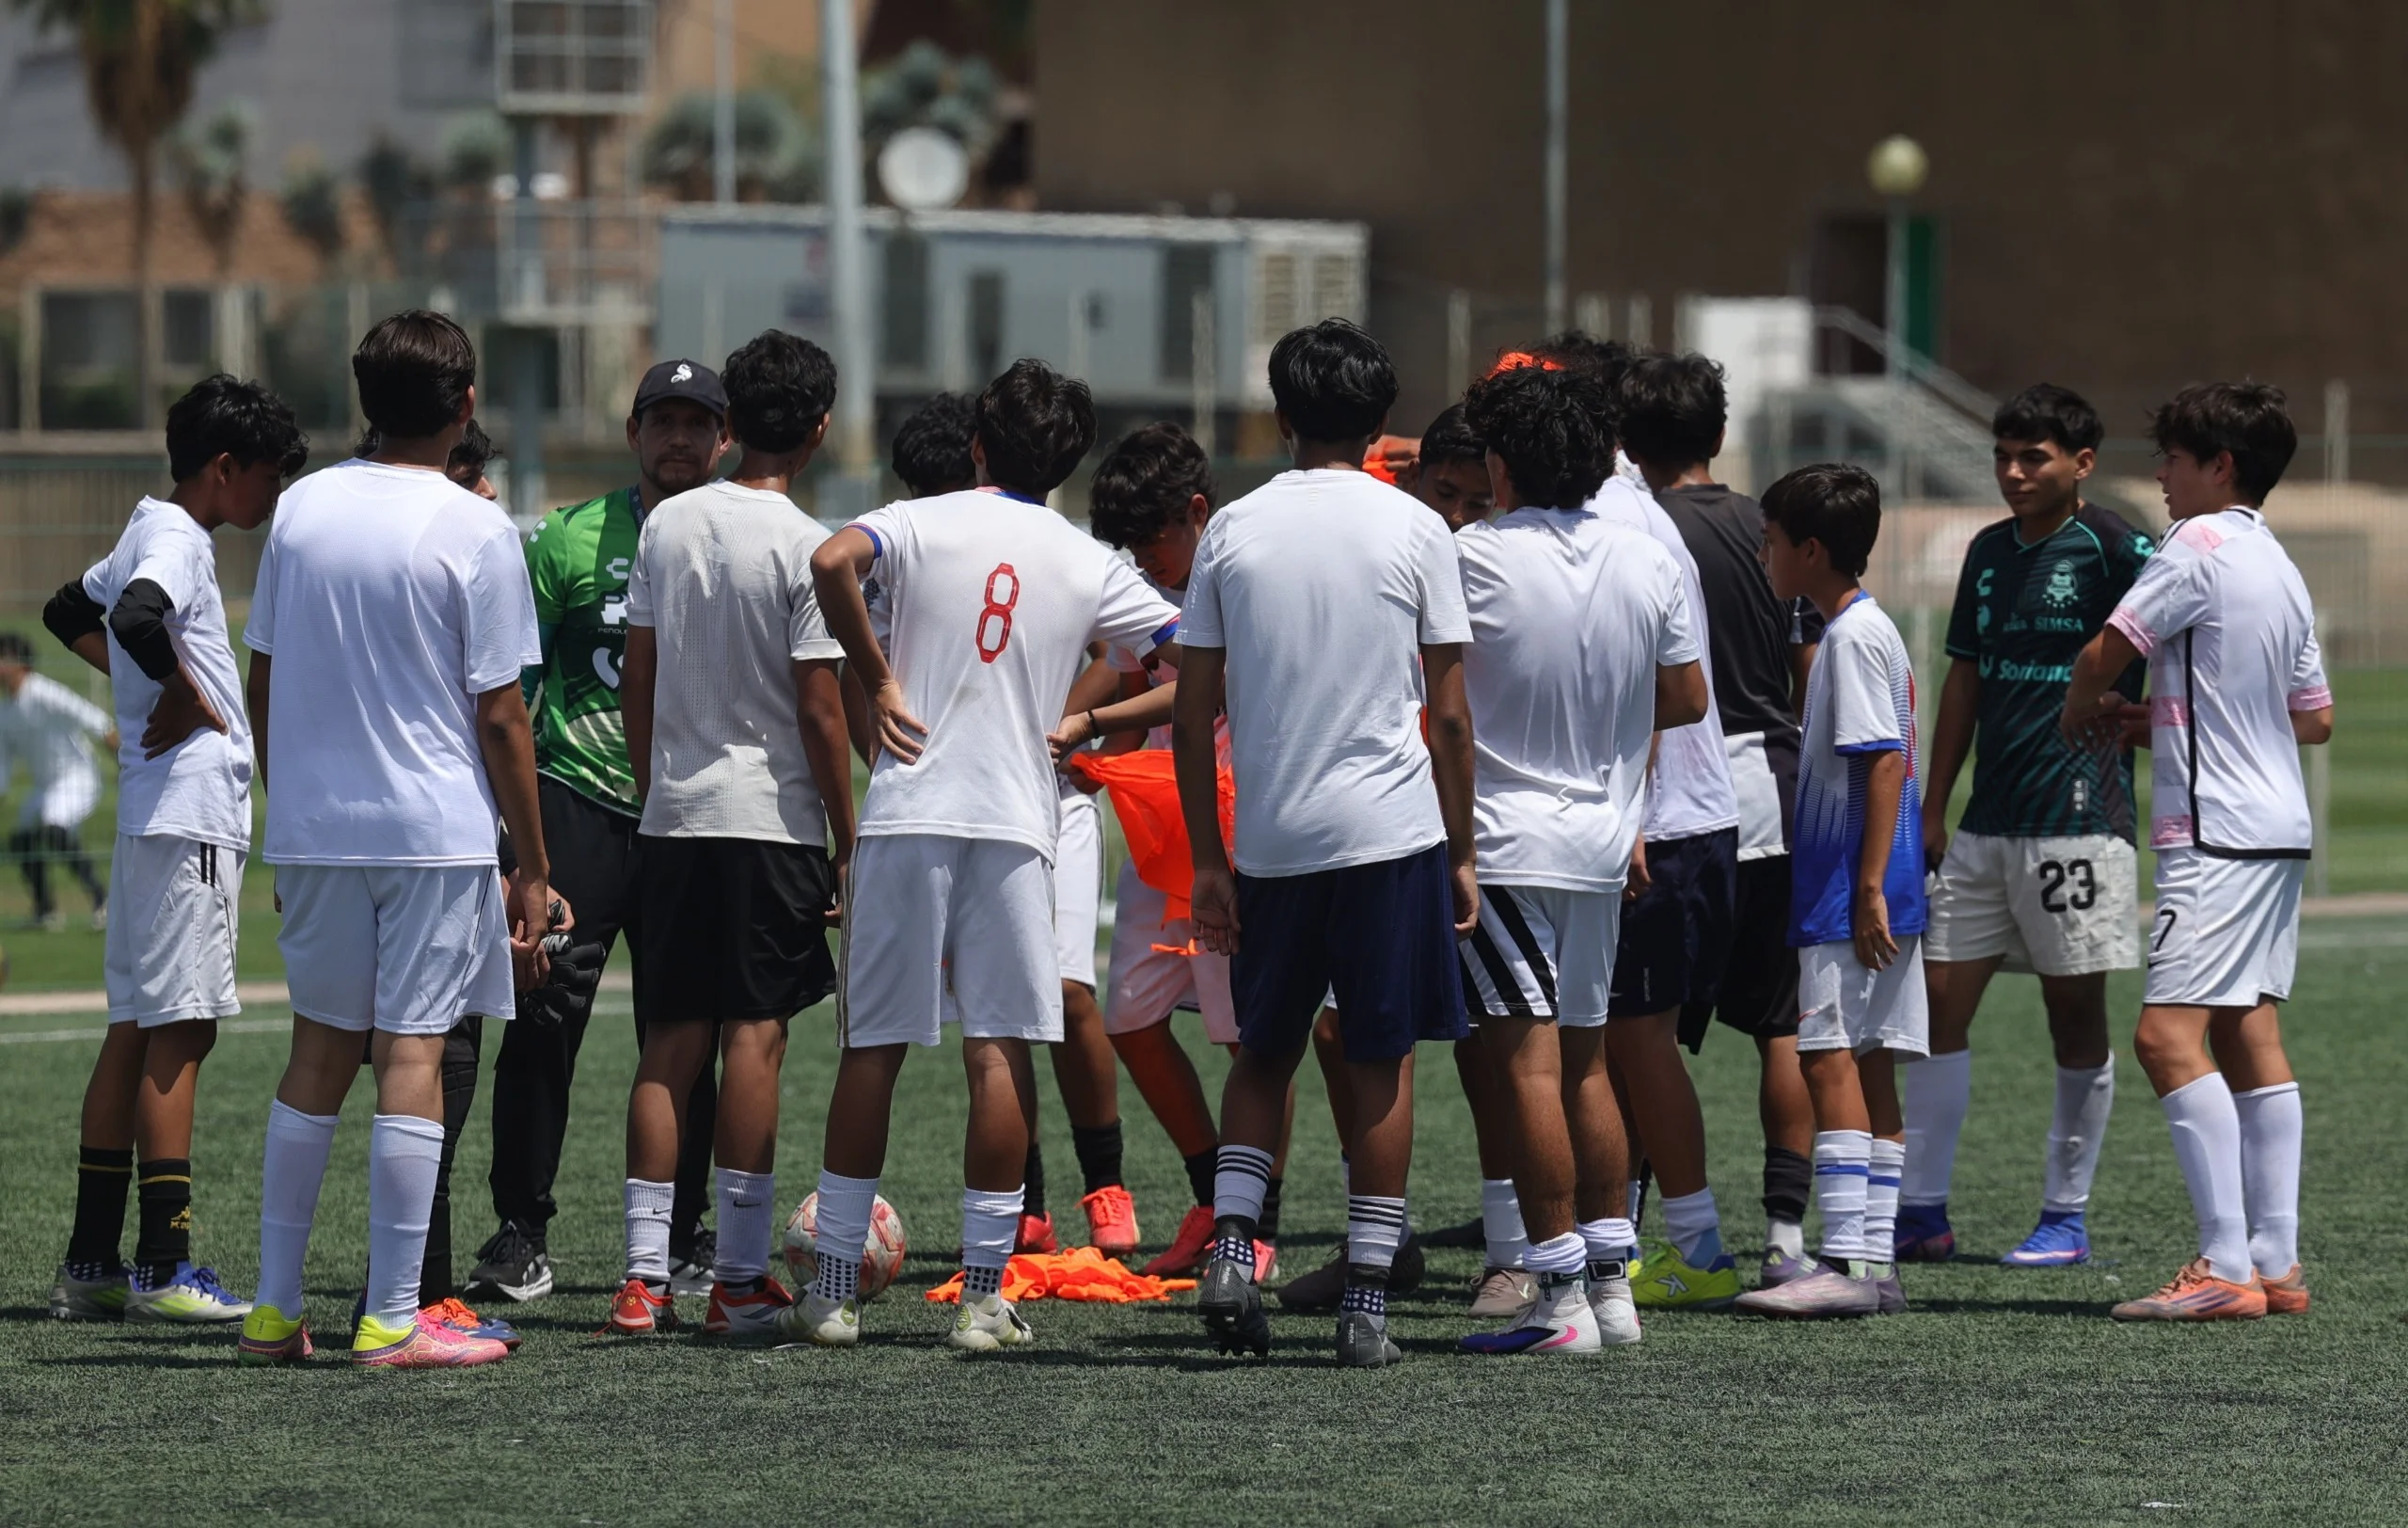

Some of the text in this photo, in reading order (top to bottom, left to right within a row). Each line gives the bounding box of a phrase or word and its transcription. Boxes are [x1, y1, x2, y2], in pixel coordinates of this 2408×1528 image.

[975, 562, 1020, 663] 8
[2034, 616, 2083, 632] SIMSA
[2039, 859, 2096, 913] 23
